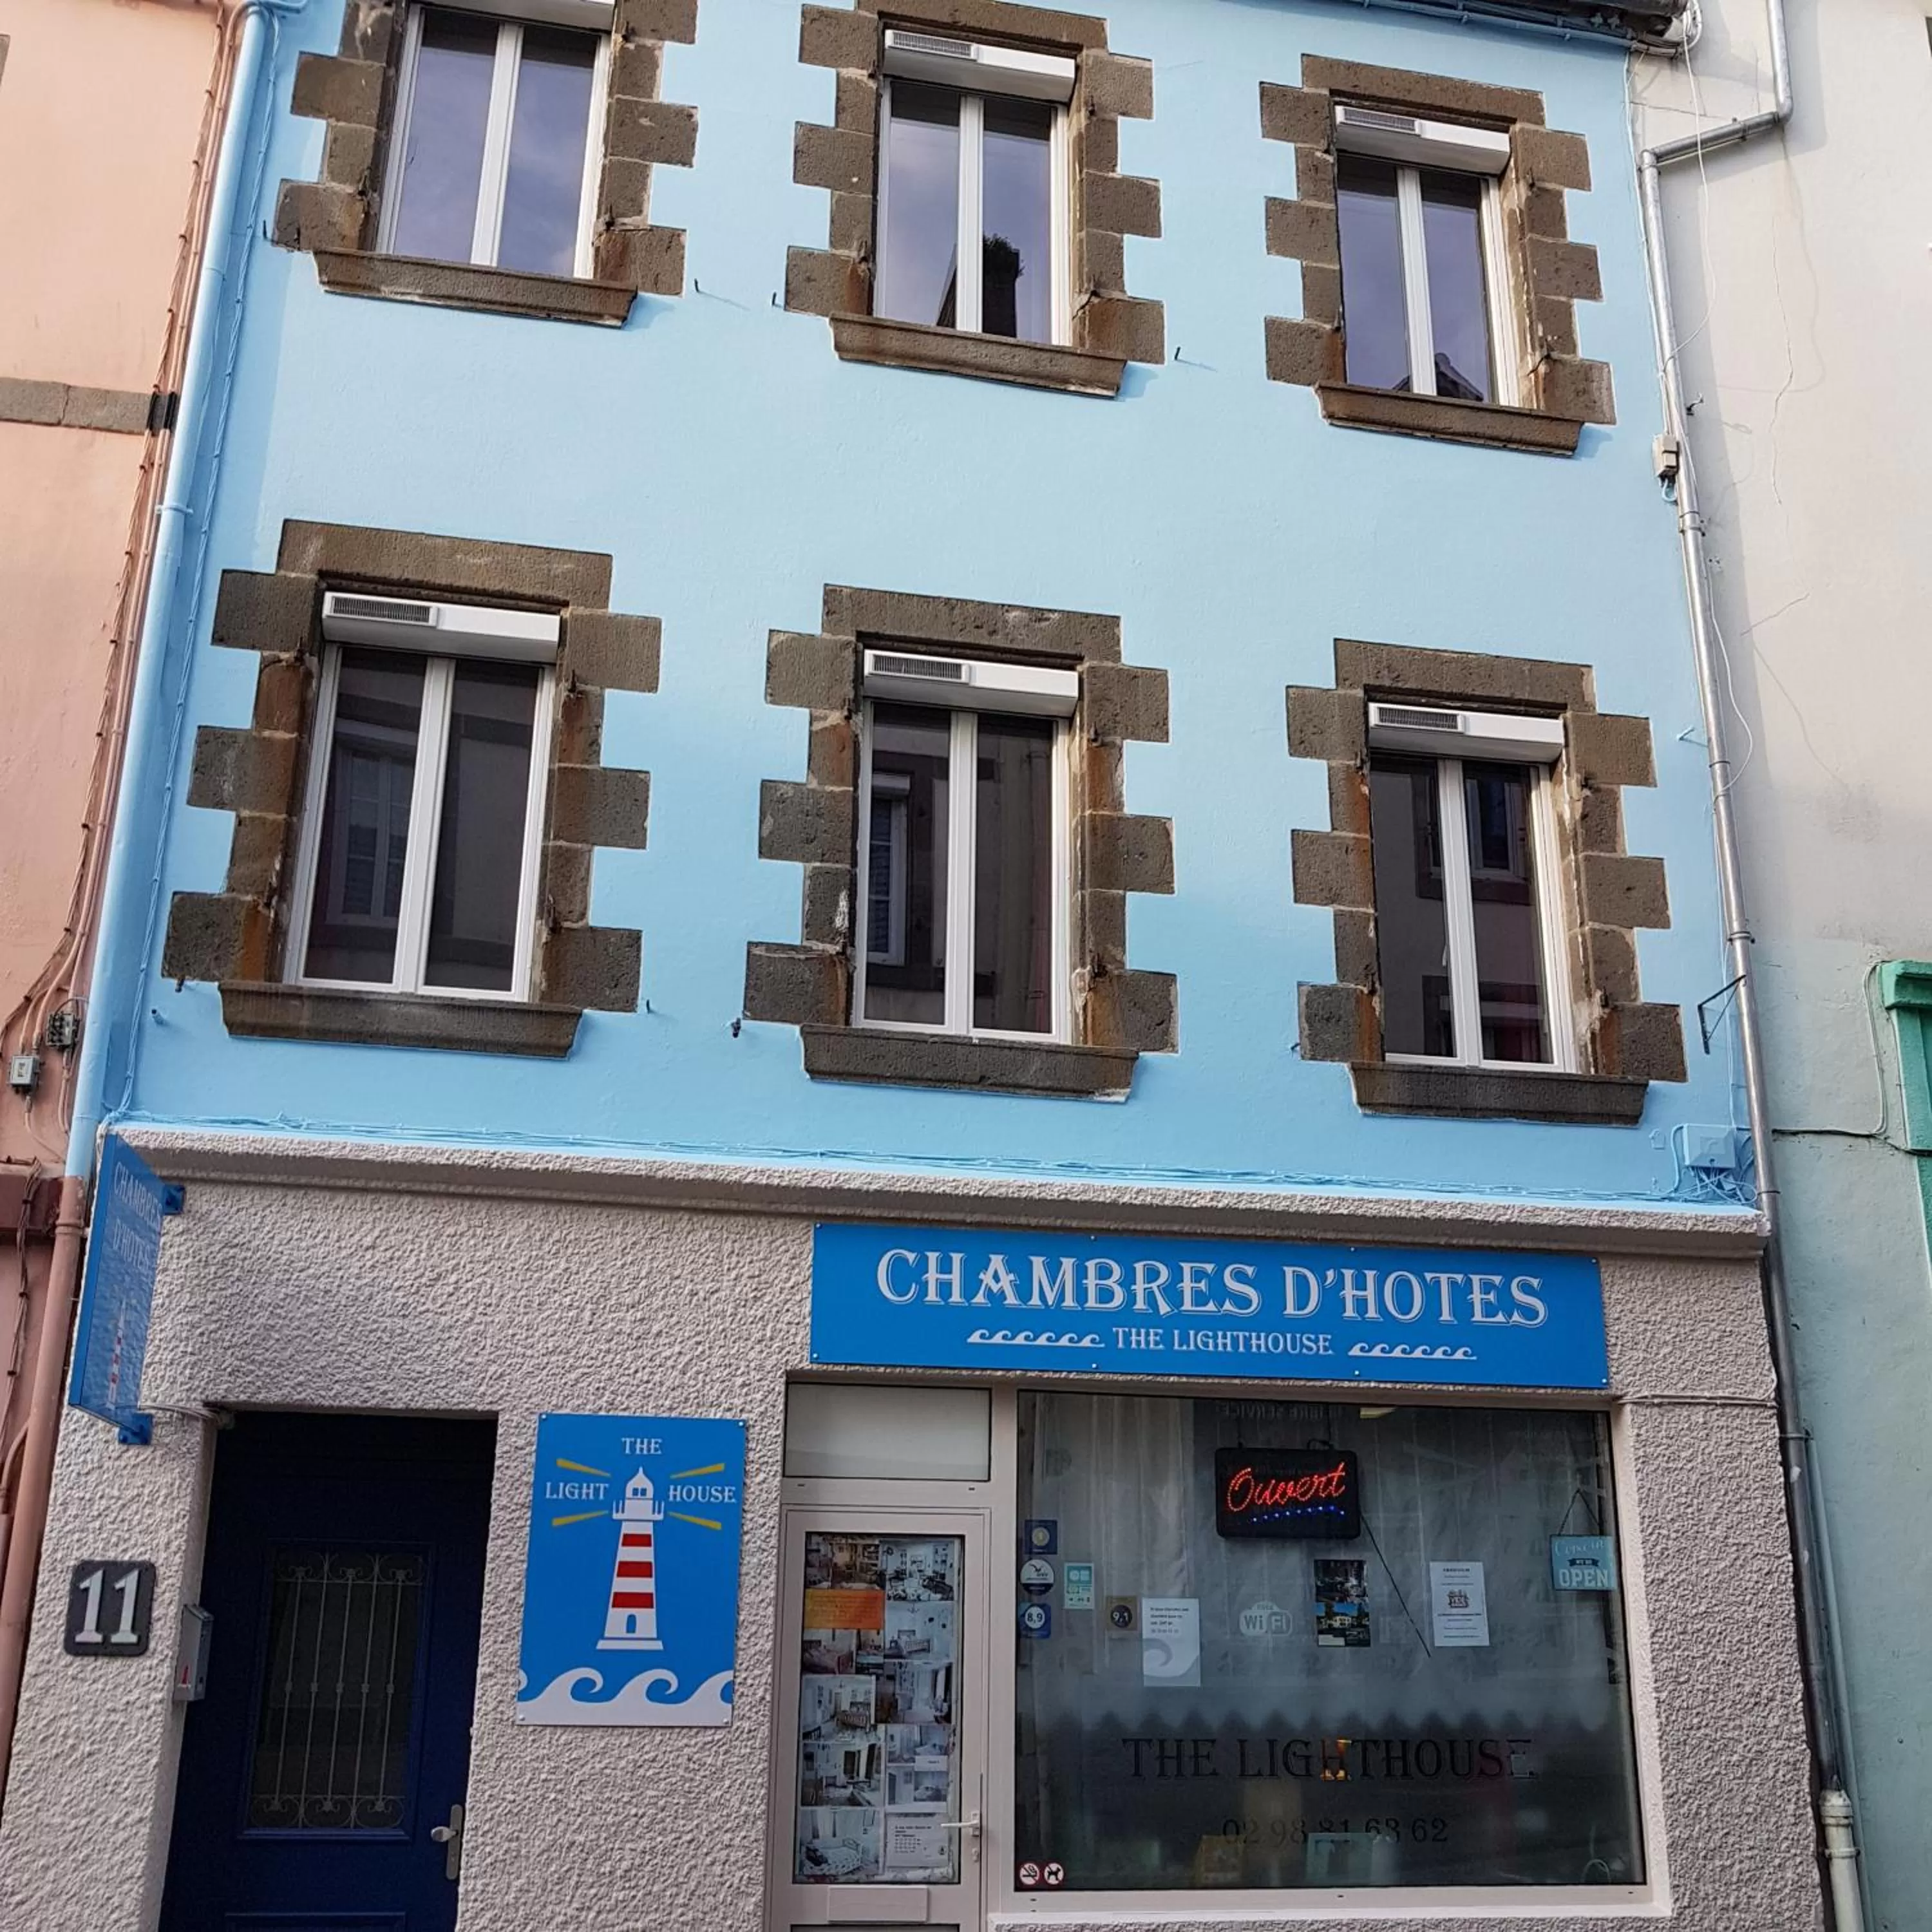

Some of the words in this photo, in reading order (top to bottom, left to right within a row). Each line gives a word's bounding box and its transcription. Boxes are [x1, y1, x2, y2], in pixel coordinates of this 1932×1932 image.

[113, 1161, 163, 1229] CHAMBRES
[876, 1248, 1264, 1318] CHAMBRES
[1282, 1265, 1548, 1329] D'HOTES
[1112, 1327, 1164, 1350] THE
[1173, 1329, 1333, 1355] LIGHTHOUSE
[621, 1437, 662, 1455] THE
[545, 1481, 609, 1500] LIGHT
[668, 1484, 736, 1503] HOUSE
[1227, 1462, 1346, 1511] Ouvert
[1559, 1568, 1609, 1588] OPEN
[75, 1568, 140, 1643] 11
[1122, 1738, 1217, 1778] THE
[1411, 1818, 1448, 1842] 62
